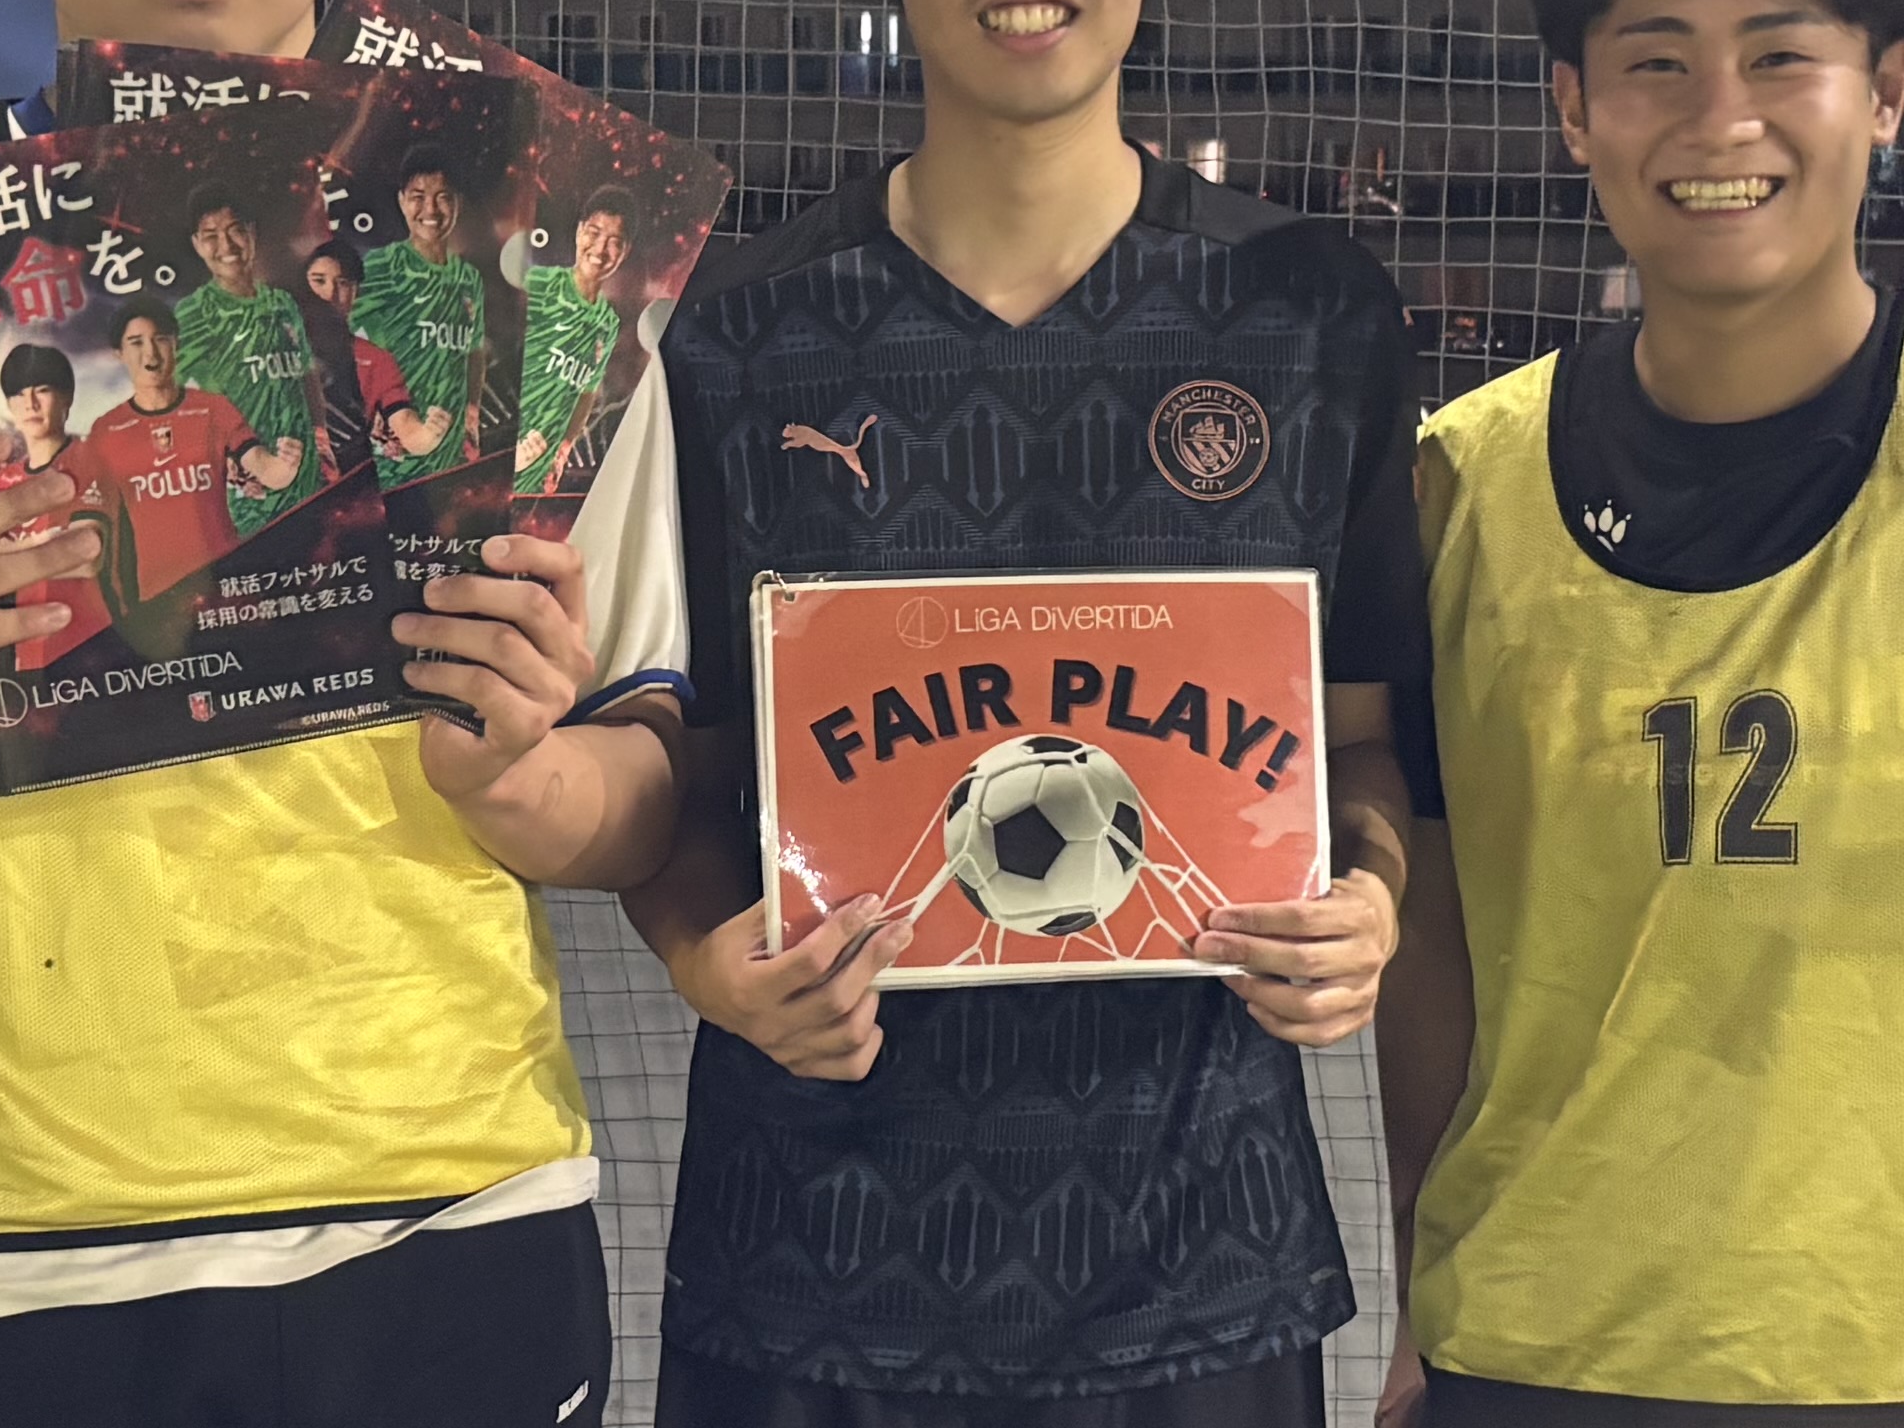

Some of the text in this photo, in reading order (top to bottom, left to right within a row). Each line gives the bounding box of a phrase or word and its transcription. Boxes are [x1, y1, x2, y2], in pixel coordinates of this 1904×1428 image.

[1162, 388, 1256, 425] MANCHESTER
[130, 463, 213, 503] POLUS
[1191, 478, 1226, 491] CITY
[219, 555, 369, 599] 就活フットサルで
[221, 668, 375, 711] URAWA REDS
[809, 658, 1301, 793] FAIR PLAY!
[1641, 689, 1799, 866] 12
